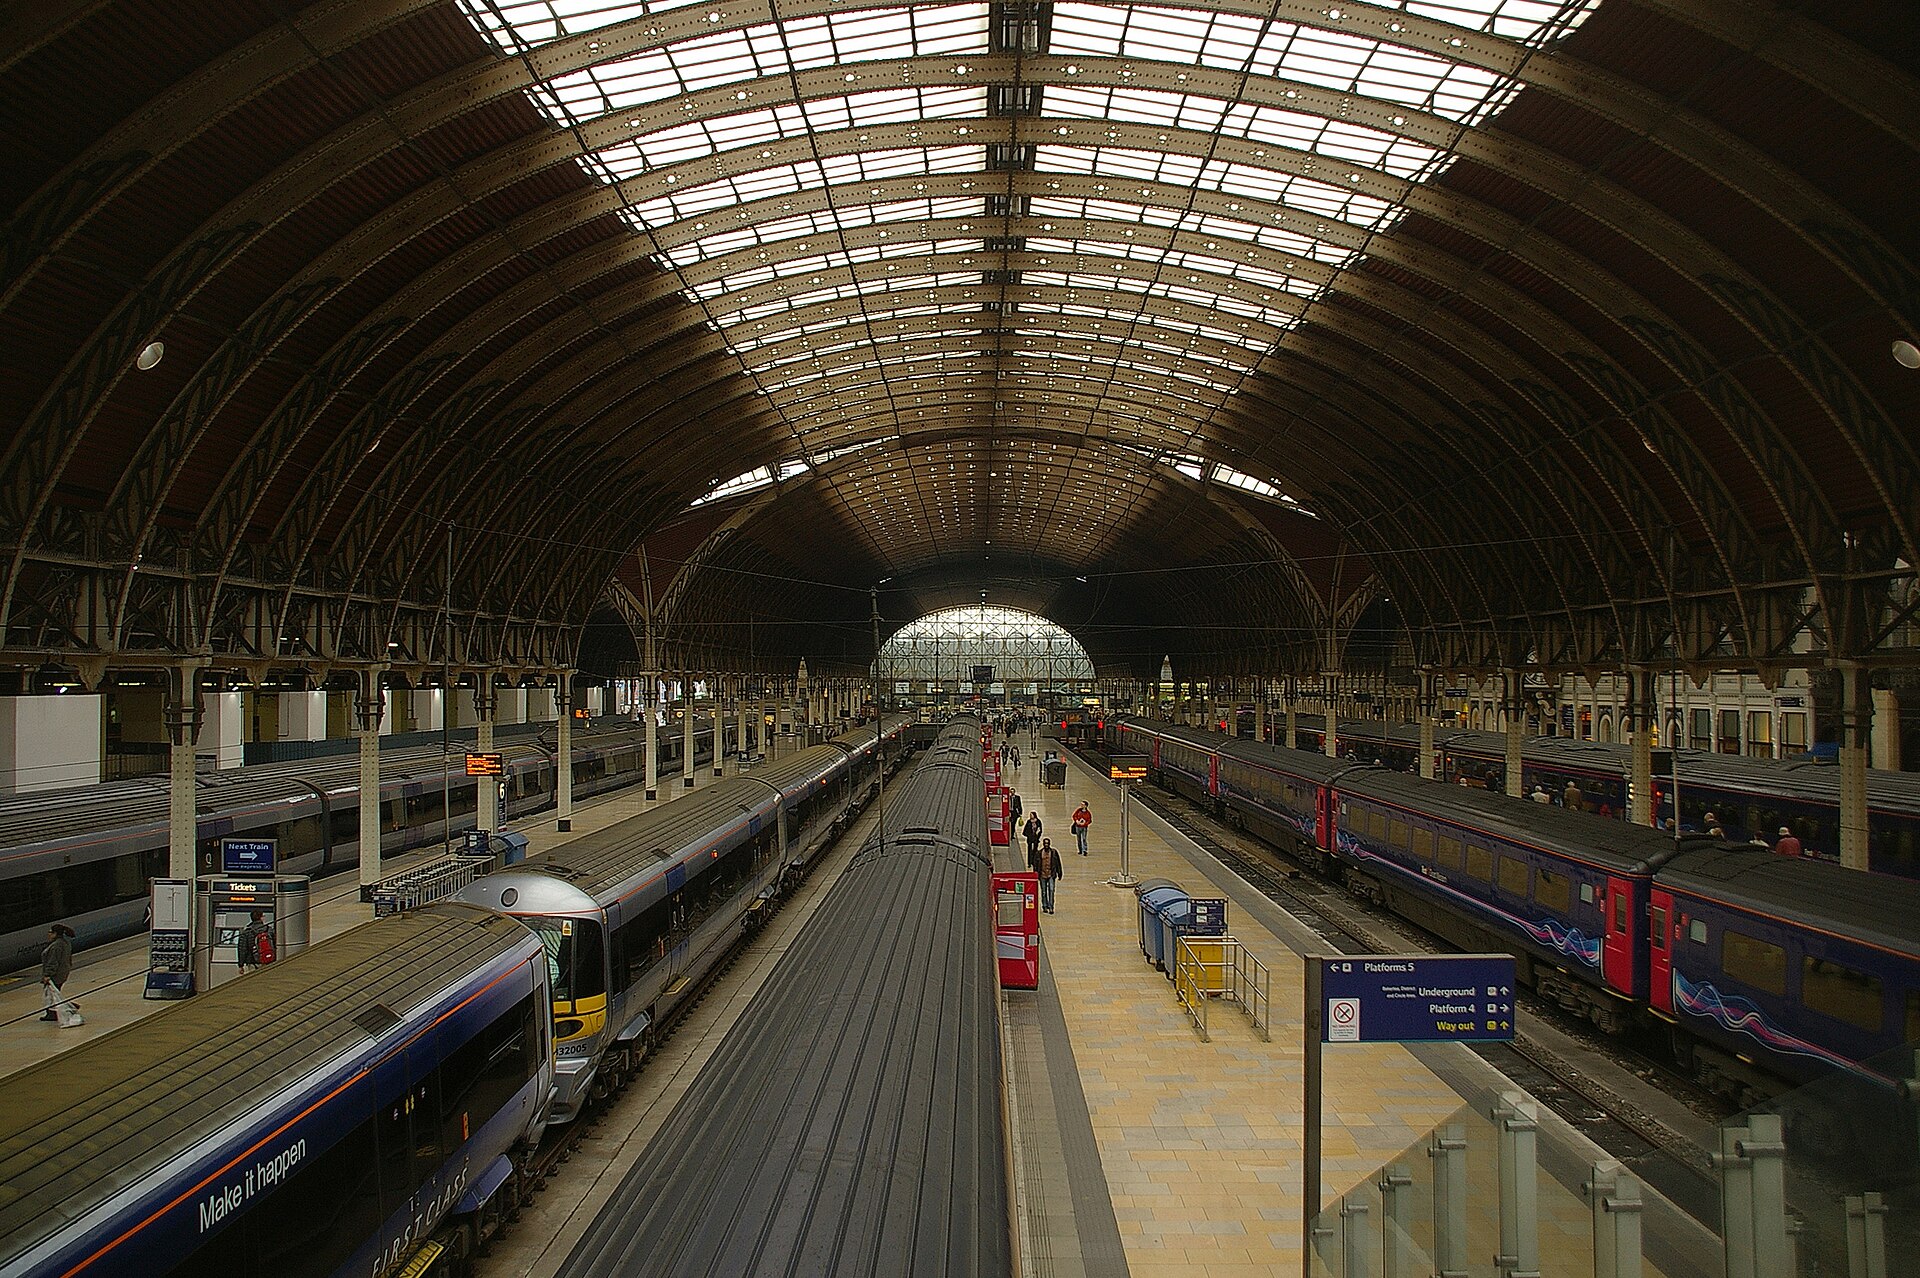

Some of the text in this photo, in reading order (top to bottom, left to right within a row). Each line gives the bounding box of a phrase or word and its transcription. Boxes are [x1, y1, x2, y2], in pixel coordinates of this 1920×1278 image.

[499, 782, 505, 799] 6
[229, 883, 257, 891] Tickets
[1364, 963, 1415, 972] Platforms 5
[1418, 987, 1475, 998] Underground
[1429, 1004, 1475, 1013] Platform 4
[1436, 1021, 1475, 1032] Way out
[199, 1138, 306, 1234] Make it happen
[371, 1167, 468, 1278] FIRST CLASS
